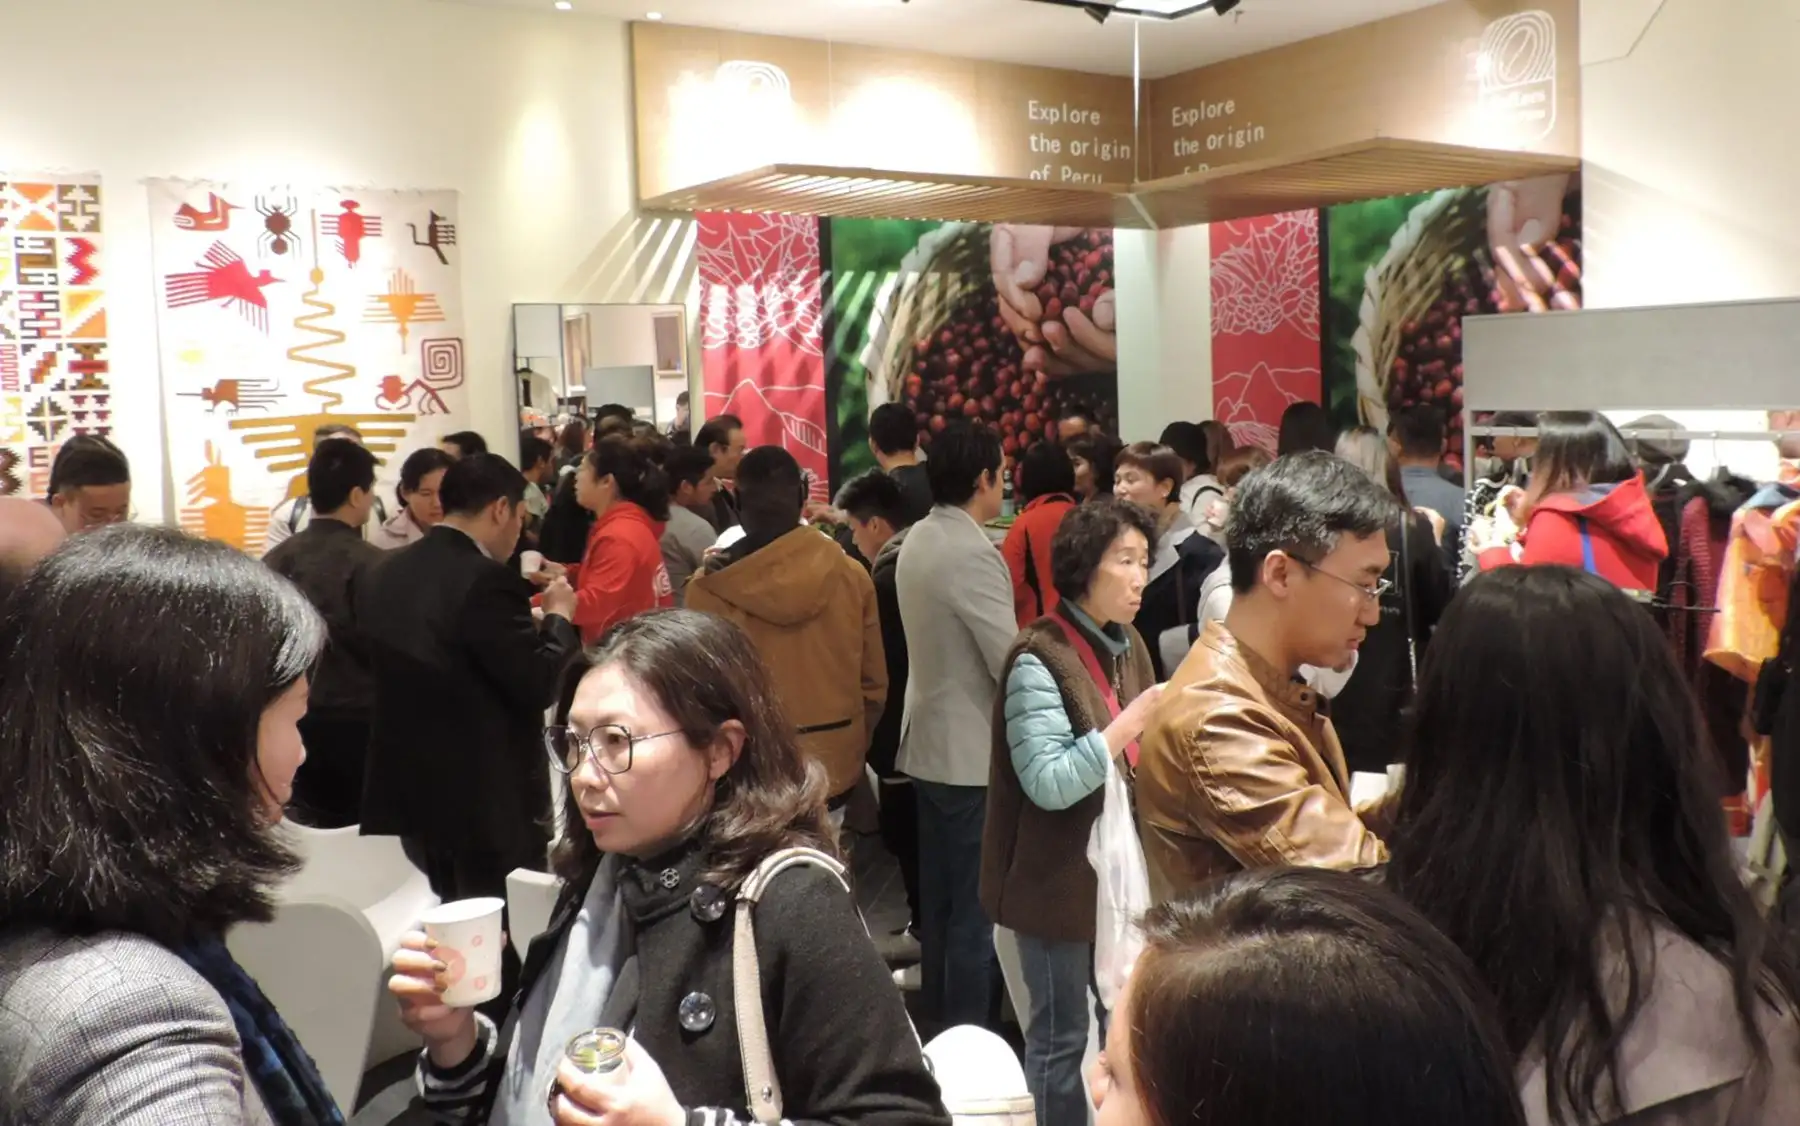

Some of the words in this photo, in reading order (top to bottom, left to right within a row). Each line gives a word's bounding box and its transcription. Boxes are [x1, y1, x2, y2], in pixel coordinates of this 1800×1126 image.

[1028, 99, 1101, 126] Explore
[1171, 99, 1235, 127] Explore
[1029, 132, 1061, 154] the
[1070, 136, 1131, 161] origin
[1173, 137, 1199, 156] the
[1206, 121, 1265, 149] origin
